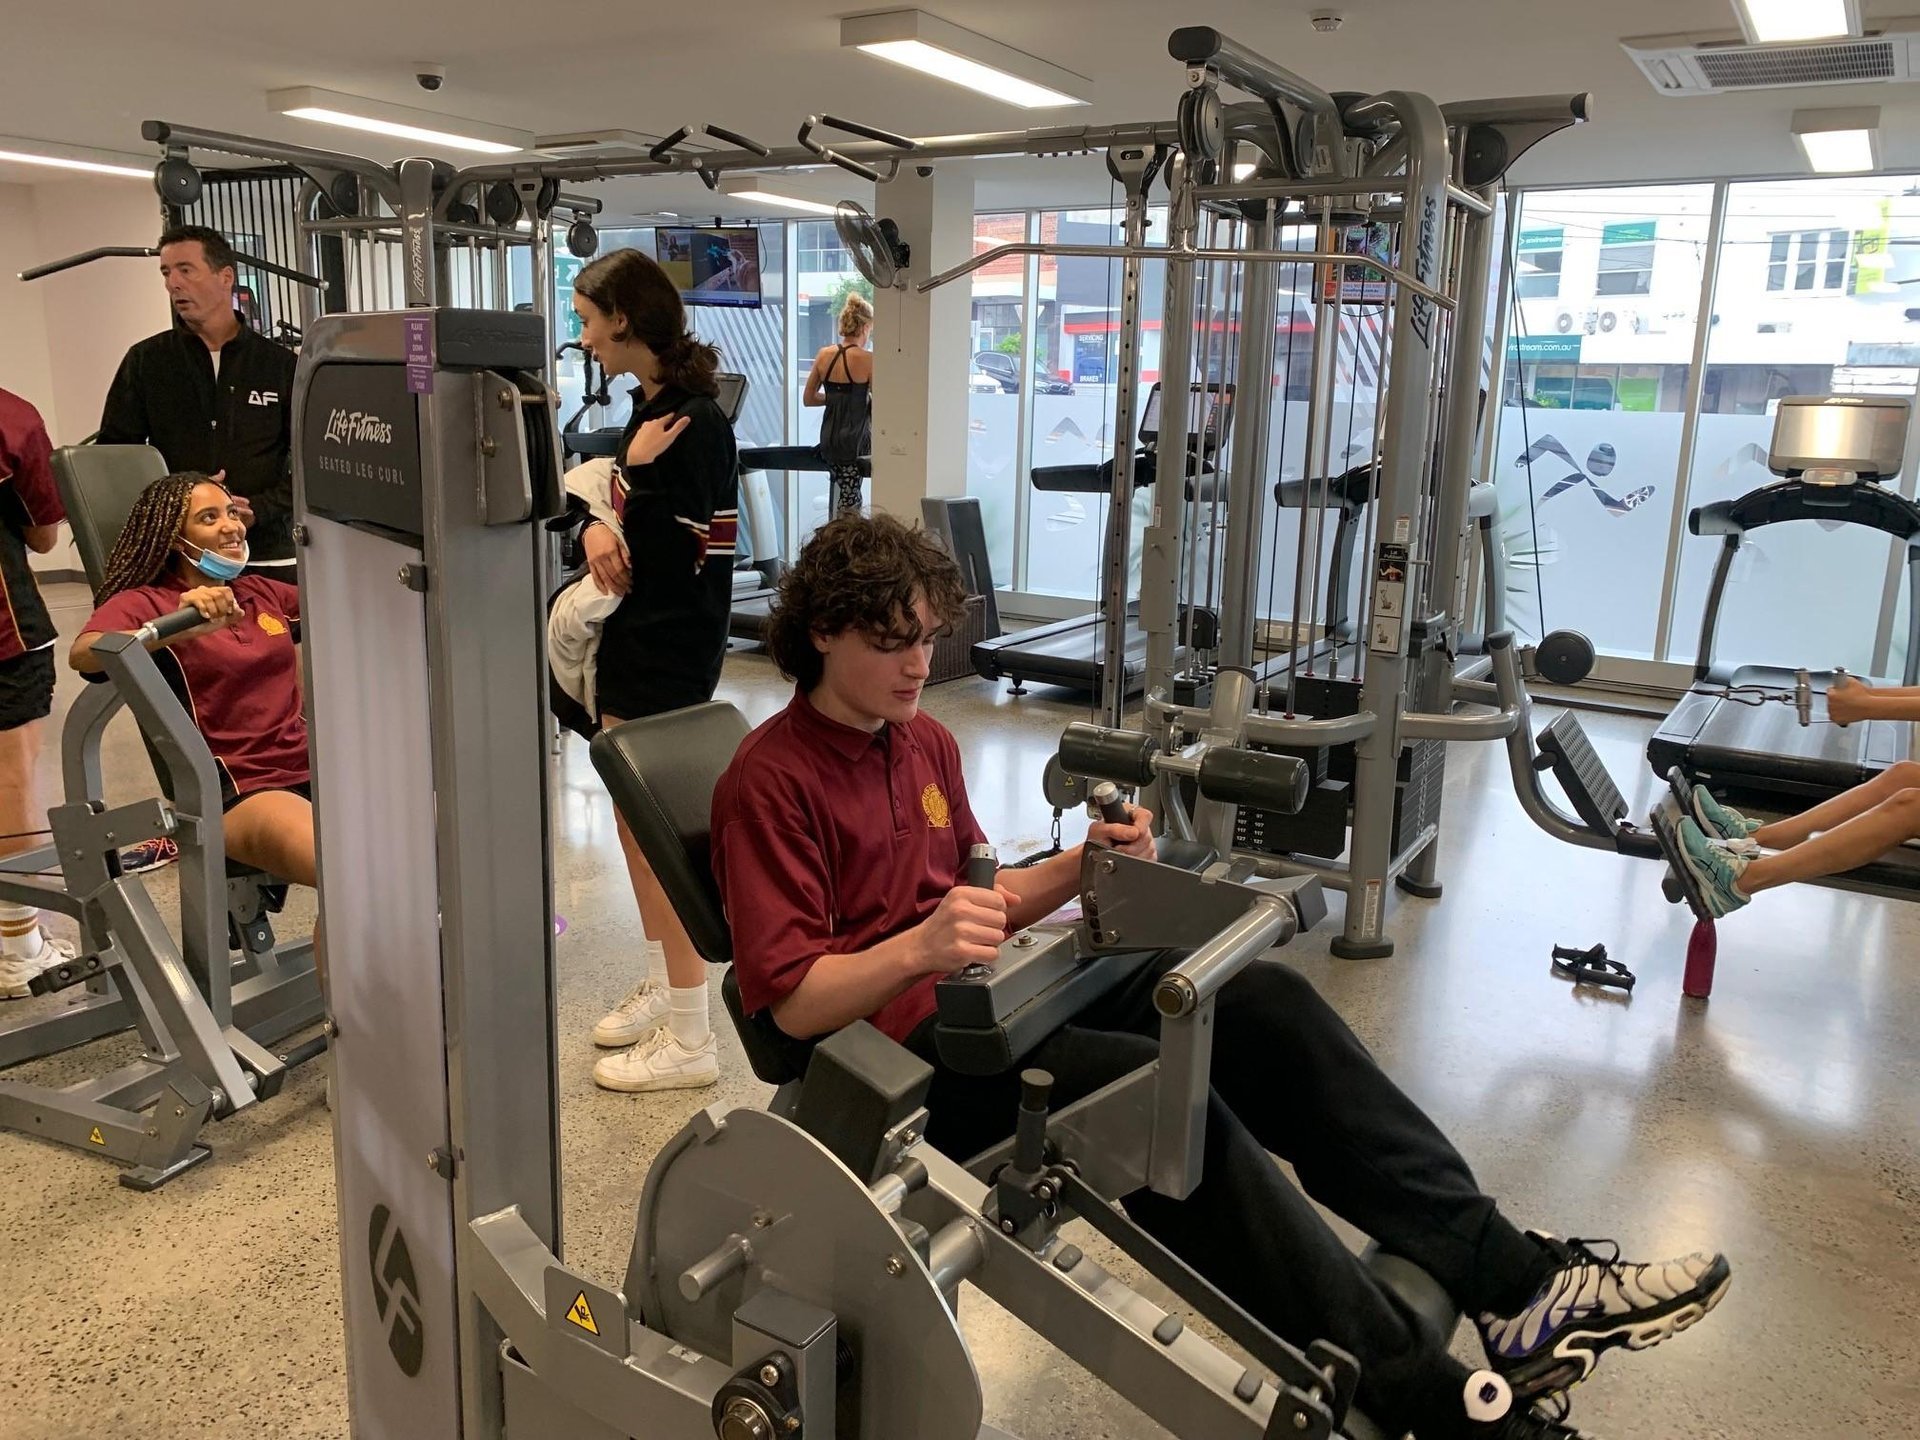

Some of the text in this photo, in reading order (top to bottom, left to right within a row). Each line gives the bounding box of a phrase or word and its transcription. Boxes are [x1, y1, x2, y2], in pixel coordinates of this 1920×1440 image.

[319, 455, 405, 485] SEATED LEG CURL
